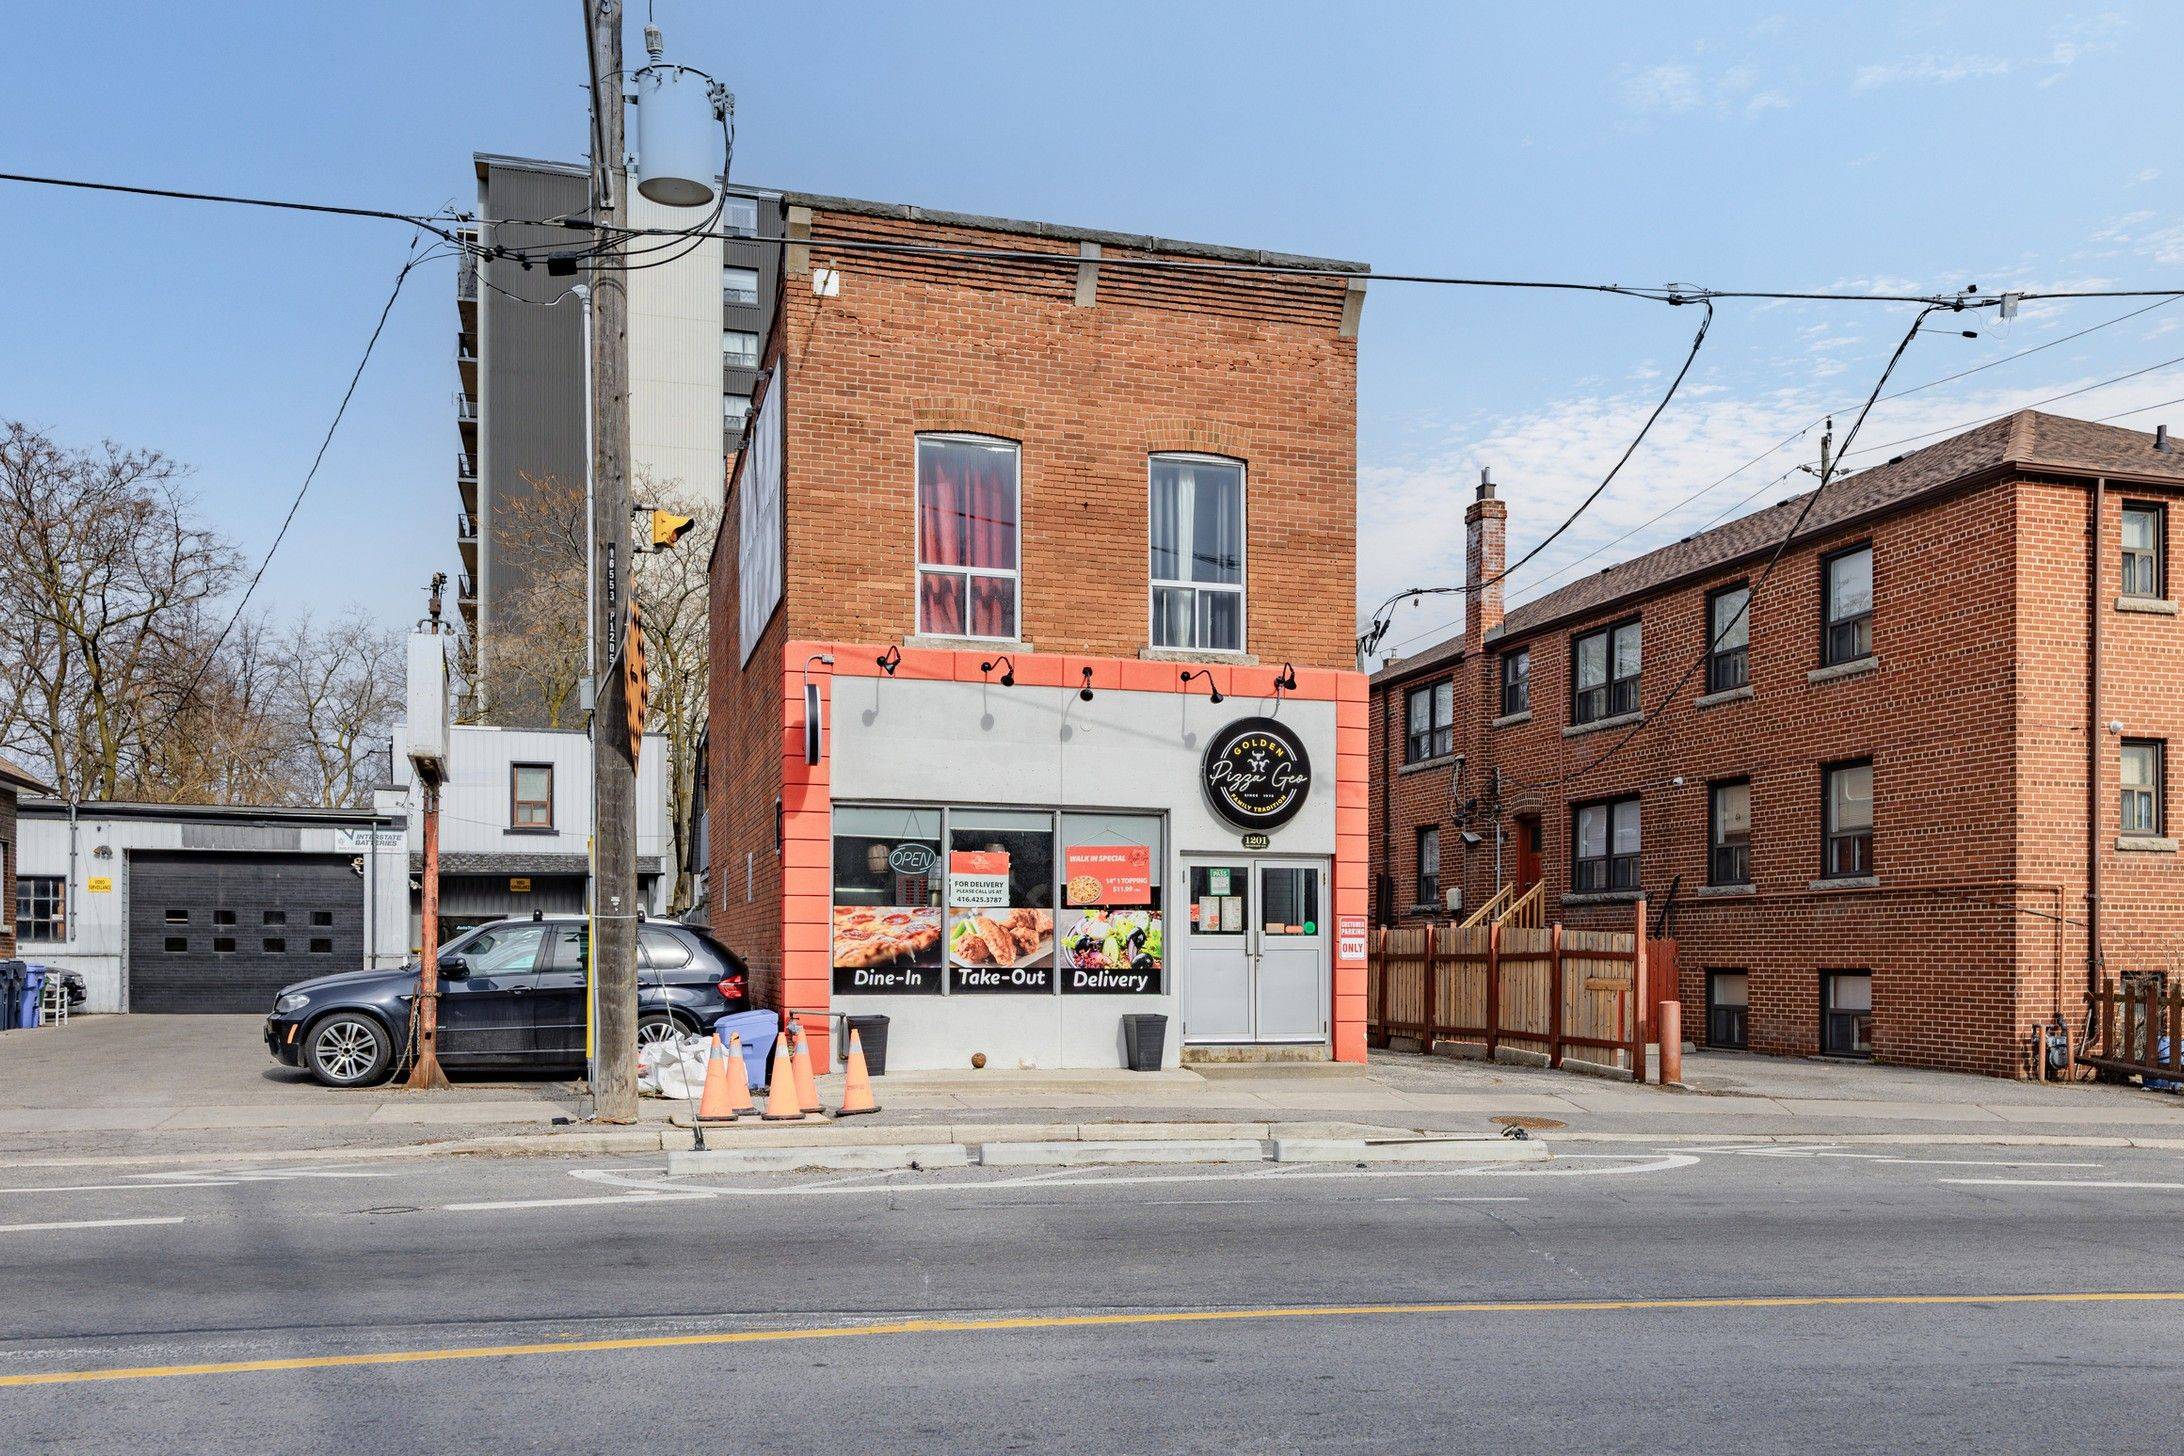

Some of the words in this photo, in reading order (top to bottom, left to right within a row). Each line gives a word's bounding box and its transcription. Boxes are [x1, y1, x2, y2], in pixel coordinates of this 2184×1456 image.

[1234, 739, 1284, 757] GOLDEN
[1210, 760, 1266, 792] Pizza
[1272, 762, 1308, 791] Geo
[1231, 793, 1252, 811] FAMILY
[1254, 794, 1287, 813] TRADITION
[1245, 836, 1266, 844] 1201
[891, 851, 931, 867] OPEN
[1069, 855, 1090, 863] WALK
[1099, 854, 1126, 862] SPECIAL
[1120, 877, 1148, 885] TOPPING
[1342, 943, 1363, 953] ONLY
[854, 969, 922, 986] Dine-In
[958, 968, 1045, 986] Take-Out
[1073, 970, 1149, 991] Delivery
